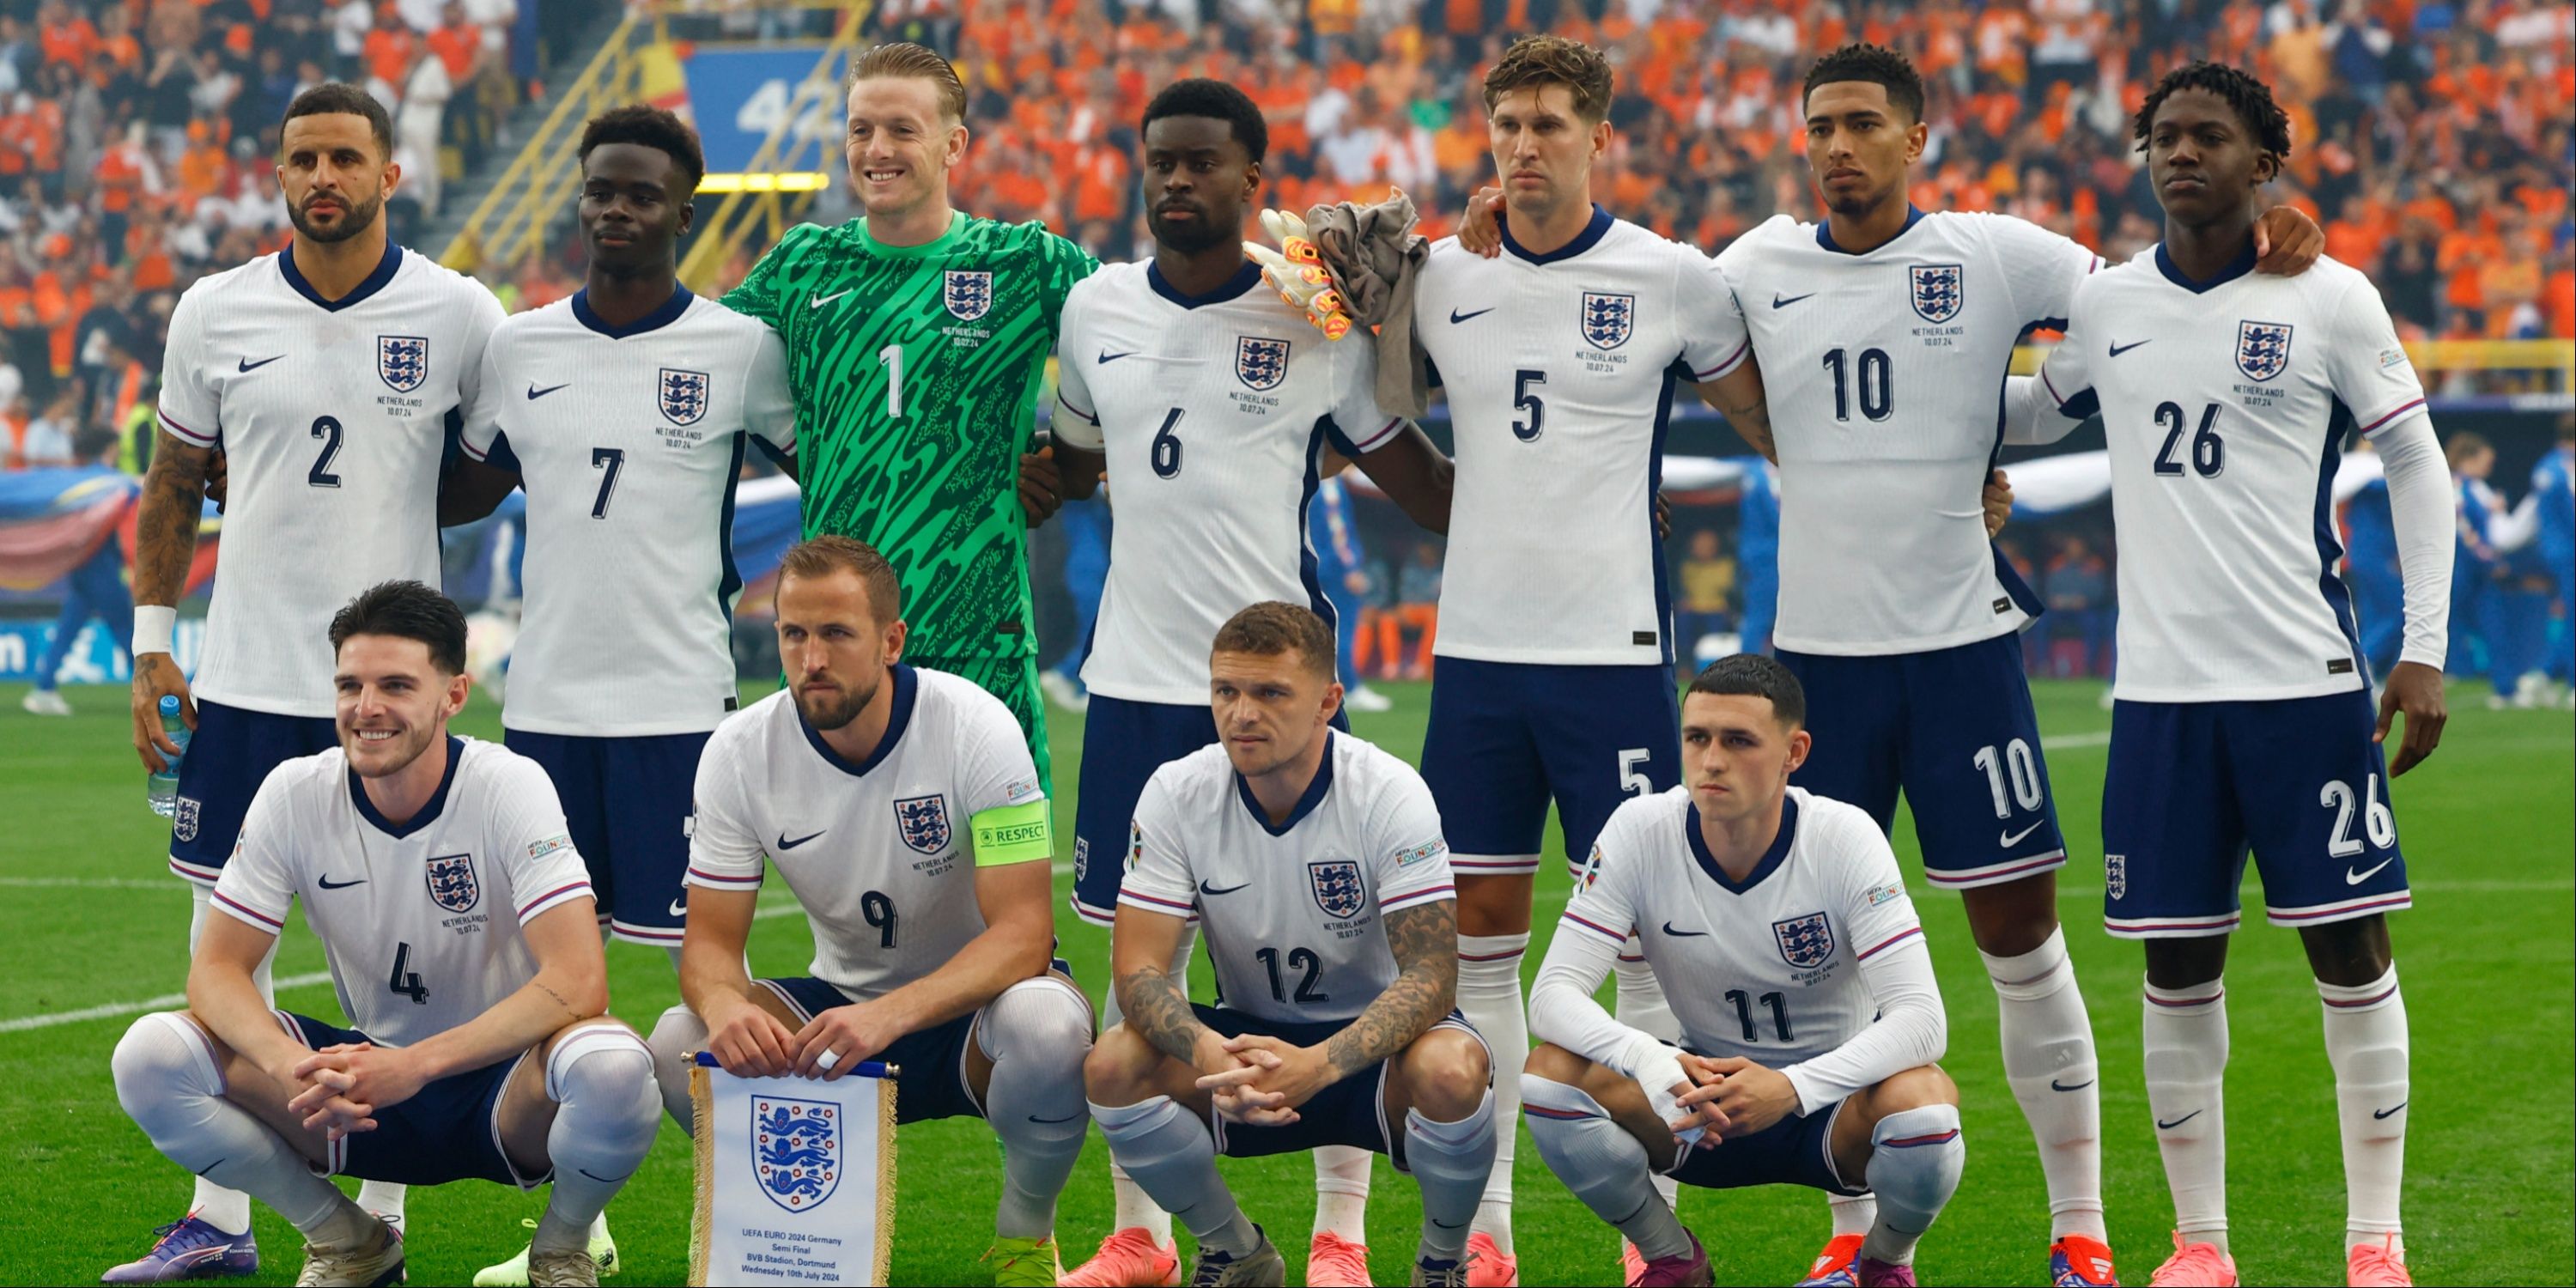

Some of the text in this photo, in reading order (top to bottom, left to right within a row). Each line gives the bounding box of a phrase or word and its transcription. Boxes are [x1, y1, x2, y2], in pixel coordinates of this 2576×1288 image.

[942, 326, 990, 338] NETHERLANDS
[1911, 326, 1964, 337] NETHERLANDS
[1924, 337, 1952, 347] 10.07.24
[1575, 350, 1628, 364] NETHERLANDS
[1586, 361, 1614, 373] 10.07.24
[879, 344, 902, 417] 1
[1823, 348, 1893, 422] 10
[1229, 392, 1279, 407] NETHERLANDS
[2233, 384, 2285, 398] NETHERLANDS
[377, 396, 422, 407] NETHERLANDS
[1239, 403, 1267, 415] 10.07.24
[1512, 370, 1547, 441] 5
[2244, 396, 2272, 406] 10.07.24
[387, 407, 412, 417] 10.07.24
[655, 427, 702, 440] NETHERLANDS
[2154, 401, 2224, 477] 26
[308, 416, 343, 488] 2
[665, 438, 691, 449] 10.07.24
[1151, 408, 1186, 479] 6
[592, 447, 625, 519] 7
[1618, 747, 1653, 797] 5
[1973, 738, 2043, 818] 10
[2320, 773, 2396, 857] 26
[996, 824, 1044, 842] RESPECT
[912, 850, 960, 871] NETHERLANDS
[441, 914, 489, 927] NETHERLANDS
[861, 891, 898, 949] 9
[1323, 914, 1372, 931] NETHERLANDS
[389, 942, 430, 1005] 4
[1255, 947, 1330, 1005] 12
[1790, 960, 1839, 981] NETHERLANDS
[1725, 989, 1795, 1042] 11
[742, 1228, 762, 1237] UEFA
[764, 1230, 787, 1239] EURO
[808, 1235, 842, 1246] Germany
[772, 1243, 811, 1255] Semi Final
[747, 1253, 835, 1268] BVB Stadion, Dortmund
[741, 1265, 840, 1281] Wednesday 10th July 2024
